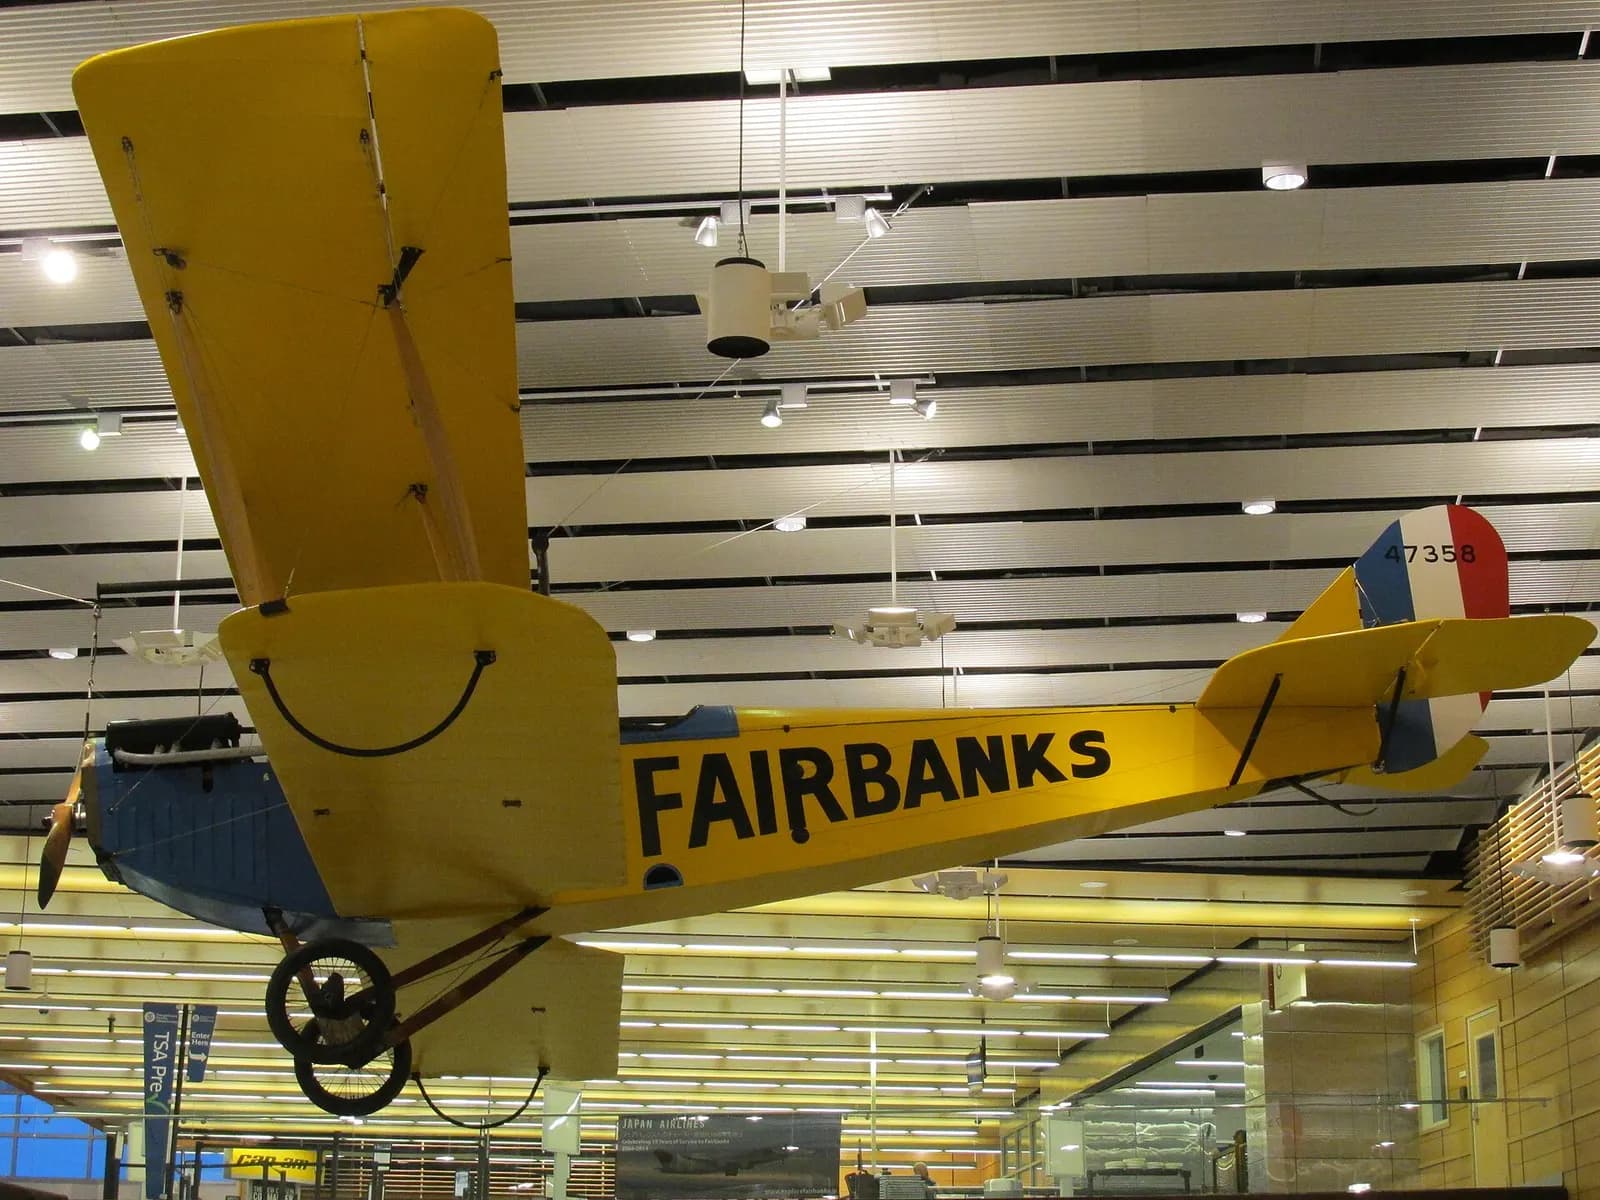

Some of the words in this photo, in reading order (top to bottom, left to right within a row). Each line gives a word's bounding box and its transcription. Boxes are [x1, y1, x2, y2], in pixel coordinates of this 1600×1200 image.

[1384, 545, 1476, 563] 47358
[633, 729, 1111, 857] FAIRBANKS
[191, 1031, 210, 1039] Enter
[153, 1032, 170, 1062] TSA
[150, 1065, 167, 1092] Pre
[622, 1118, 653, 1129] JAPAN
[659, 1119, 705, 1129] AIRLINES
